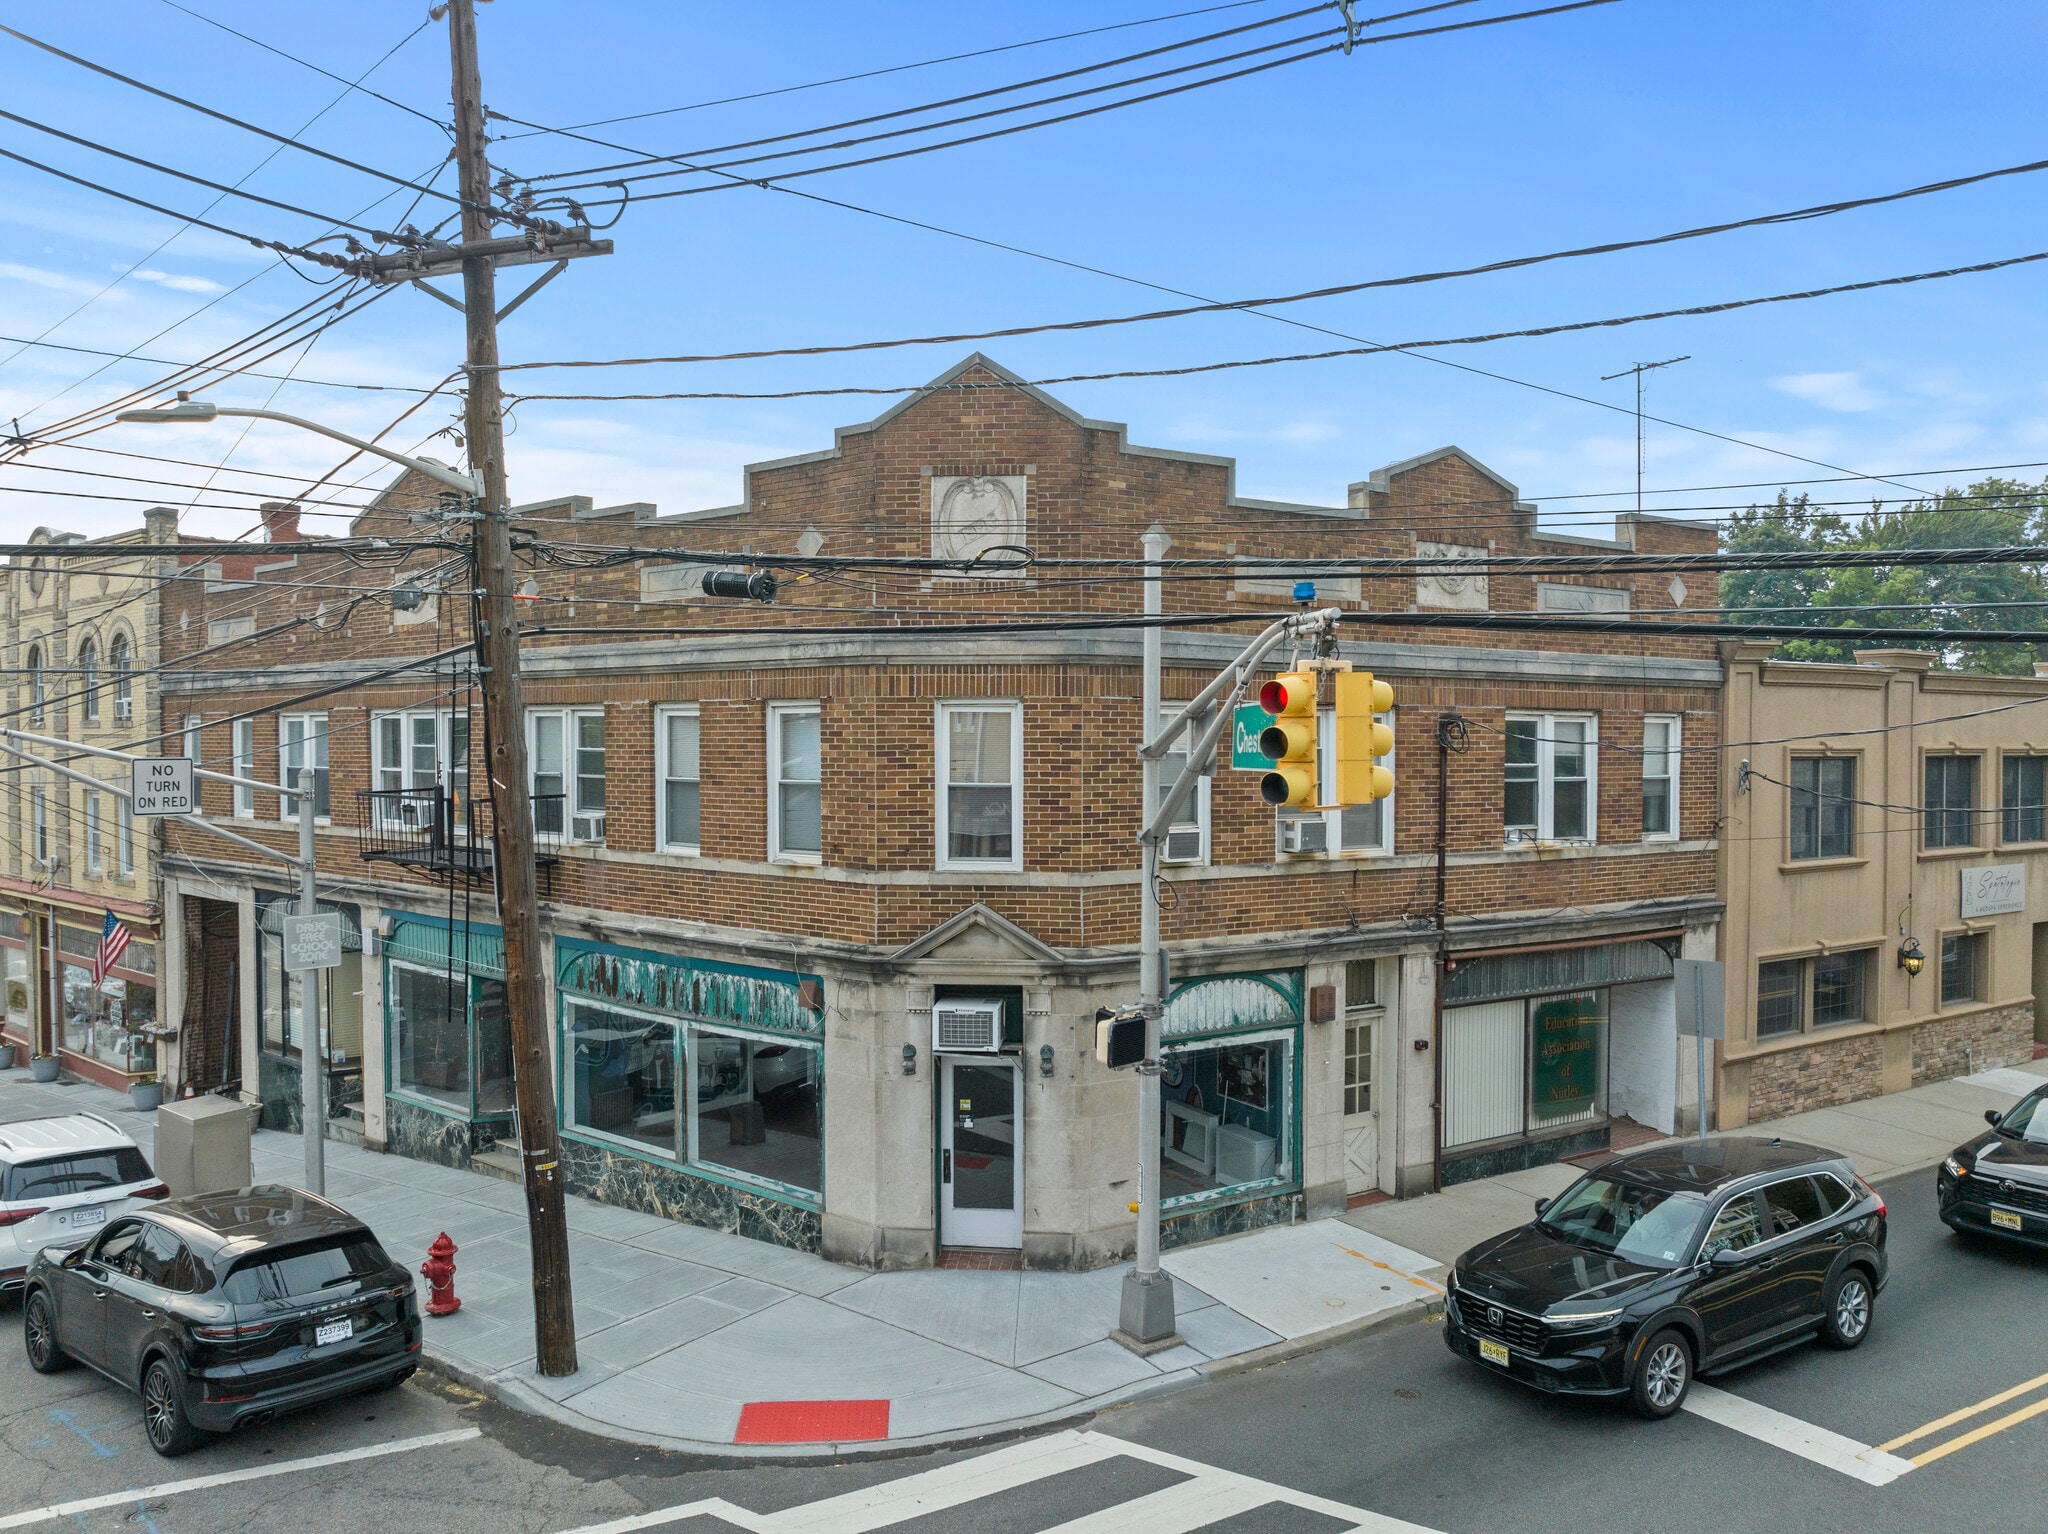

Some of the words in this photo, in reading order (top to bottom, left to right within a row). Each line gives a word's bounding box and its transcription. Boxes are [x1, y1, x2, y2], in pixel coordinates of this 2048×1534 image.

[152, 765, 174, 776] NO
[146, 780, 180, 792] TURN
[138, 797, 156, 808] ON
[162, 796, 188, 808] RED
[300, 931, 326, 943] FREE
[290, 940, 336, 954] SCHOOL
[298, 950, 329, 963] ZONE
[1545, 1013, 1588, 1031] Education
[1541, 1038, 1592, 1057] Association
[1561, 1063, 1572, 1078] of
[1551, 1084, 1580, 1101] Nutley
[299, 1296, 366, 1317] PORSCHE
[318, 1323, 350, 1337] Z237399
